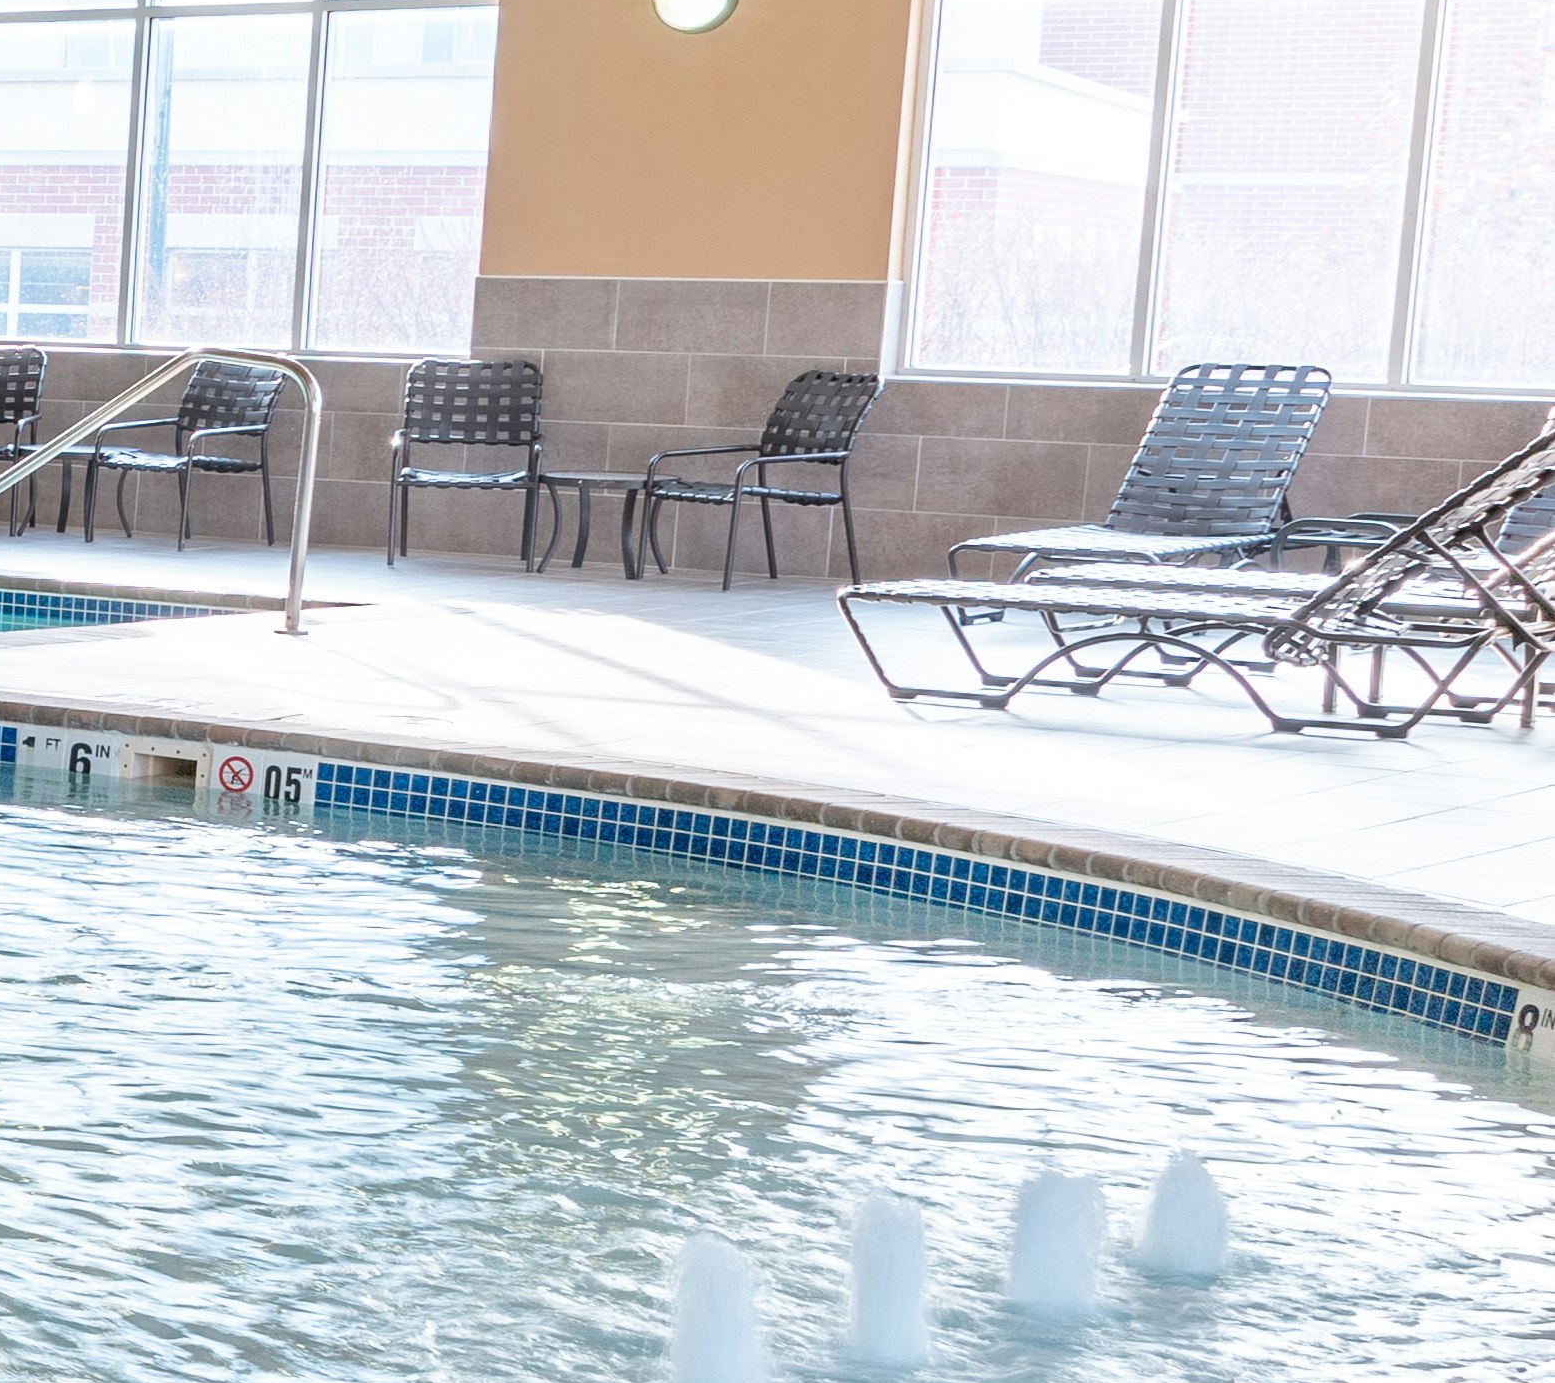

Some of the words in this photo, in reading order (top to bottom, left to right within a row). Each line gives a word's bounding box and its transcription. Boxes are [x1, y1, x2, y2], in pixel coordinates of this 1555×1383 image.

[46, 738, 61, 750] FT
[69, 743, 92, 774] 6
[95, 744, 110, 758] IN
